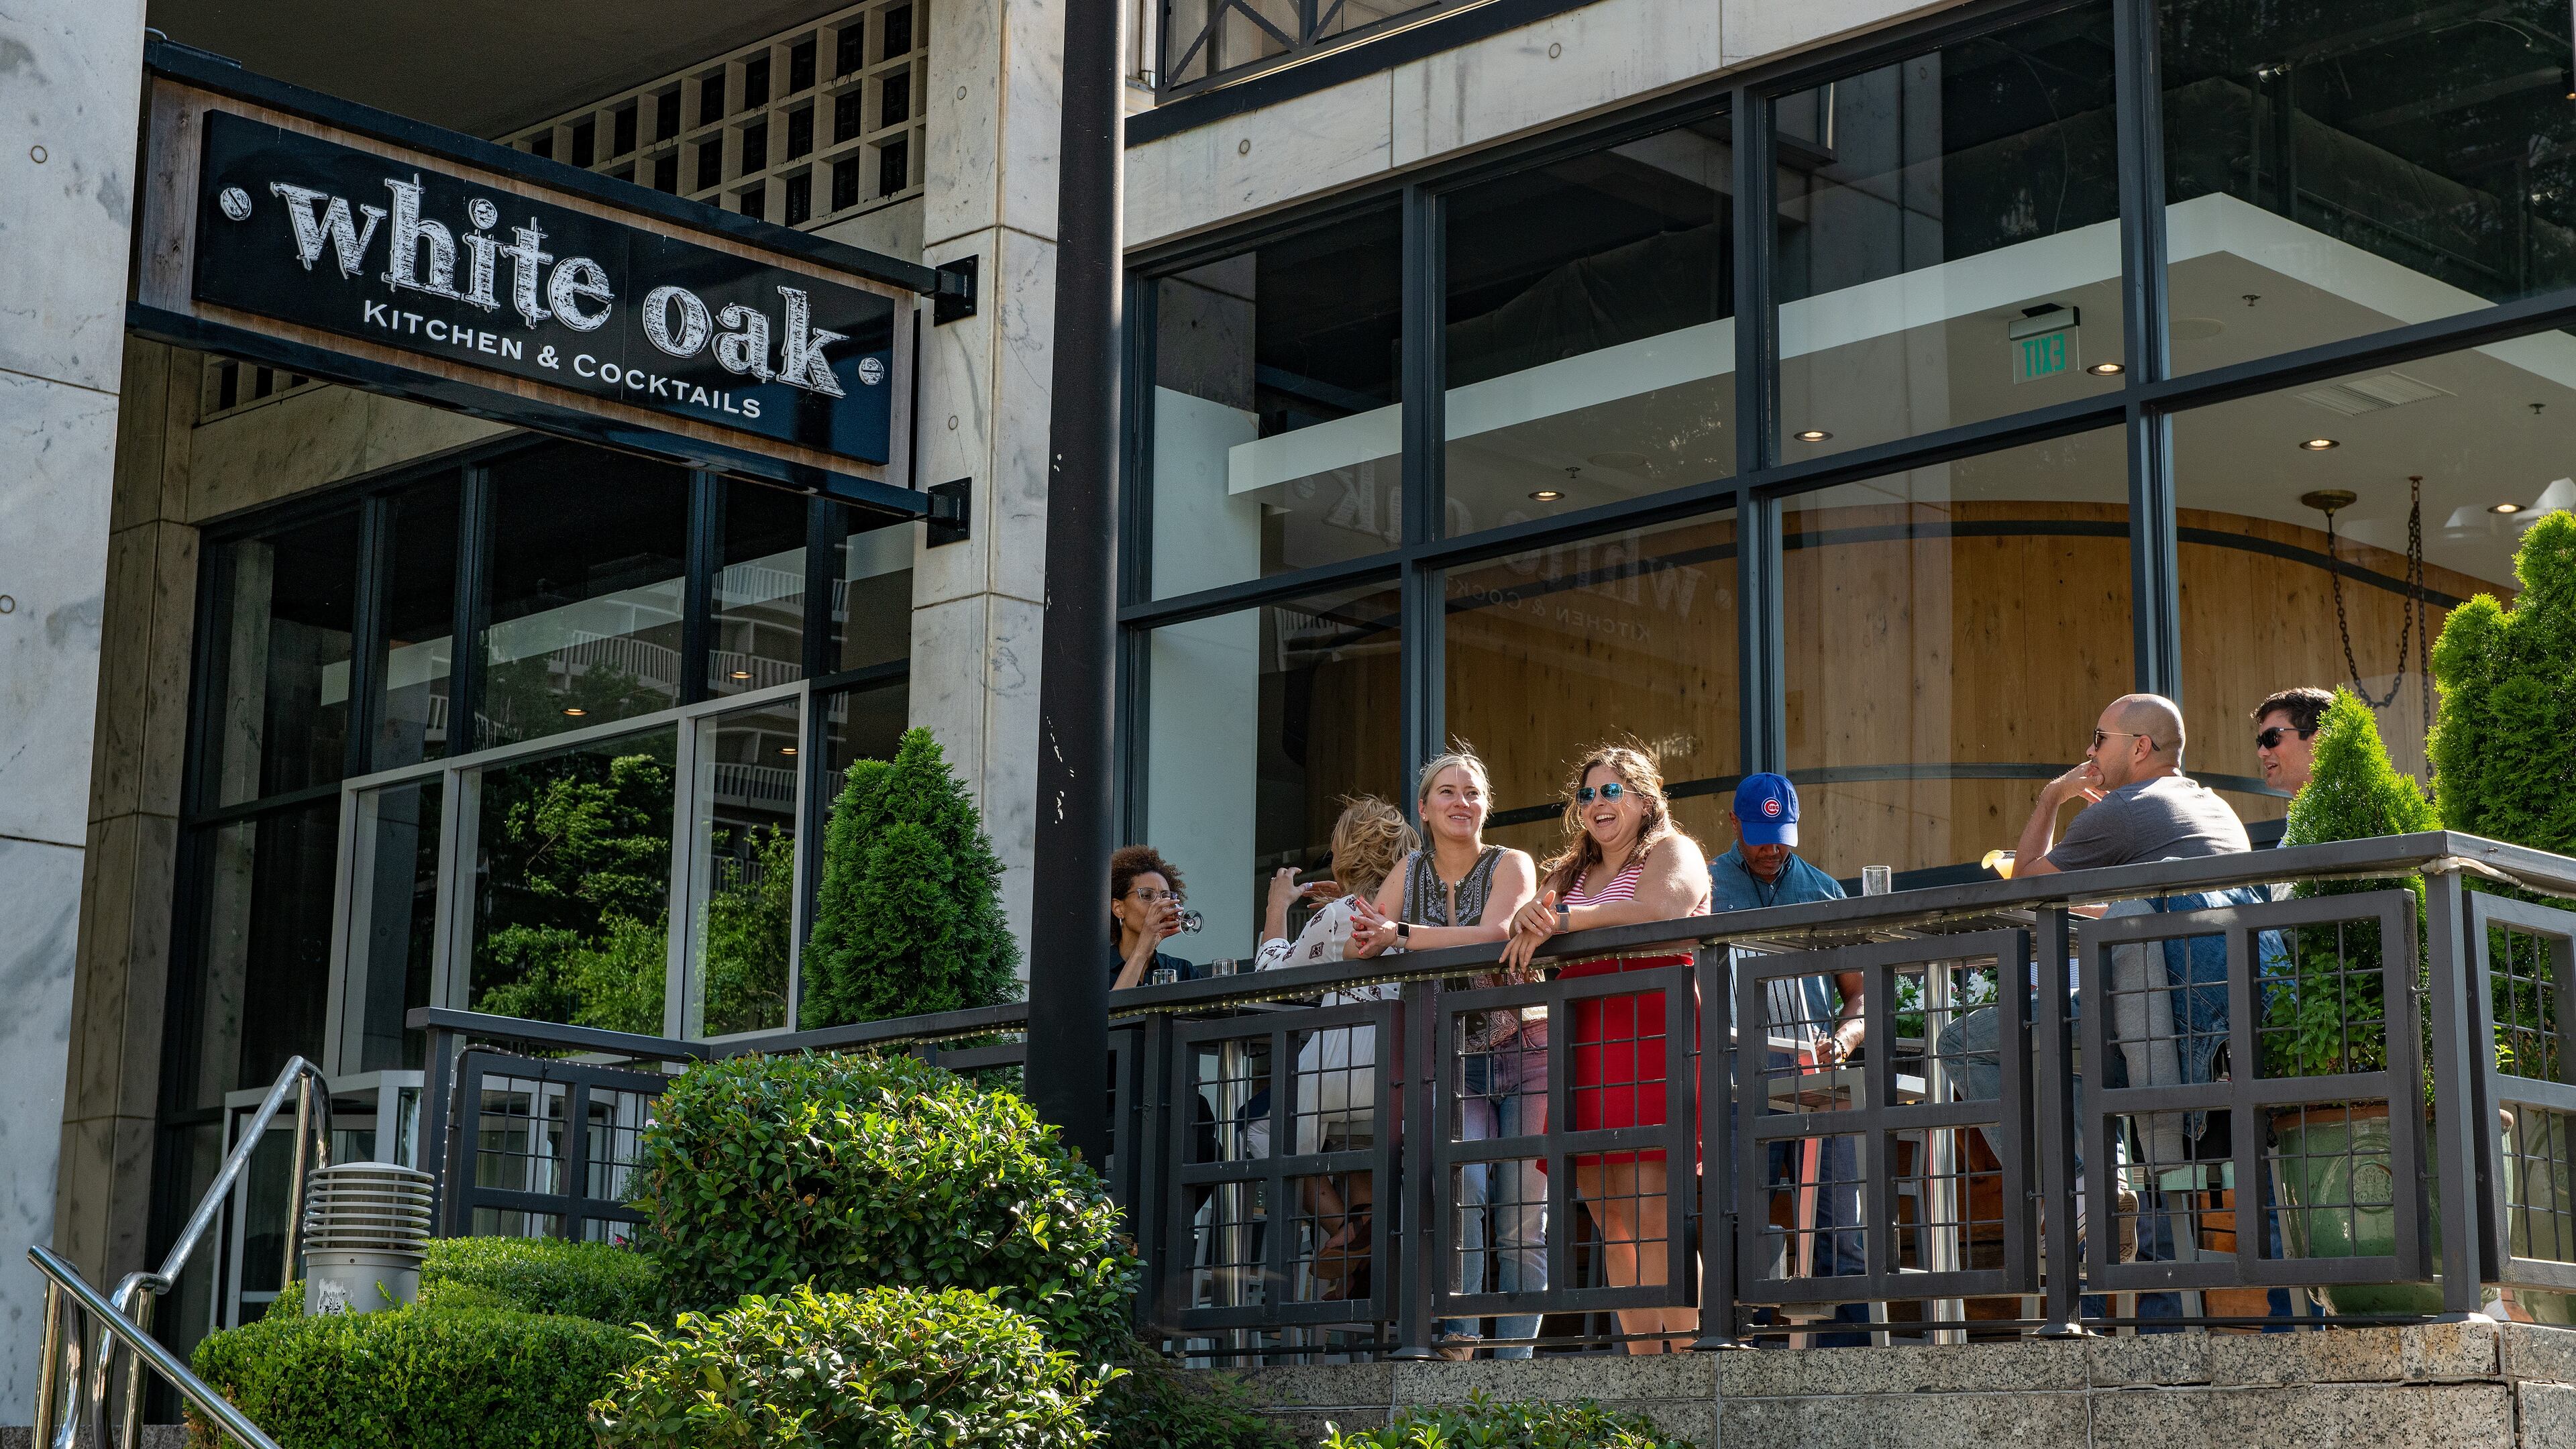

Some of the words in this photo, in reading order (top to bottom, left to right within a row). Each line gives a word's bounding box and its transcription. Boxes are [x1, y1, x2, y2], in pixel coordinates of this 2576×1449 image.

[270, 172, 616, 331] white
[643, 284, 849, 398] oak
[364, 300, 523, 360] KITCHEN
[537, 345, 559, 370] &
[573, 354, 761, 419] COCKTAILS
